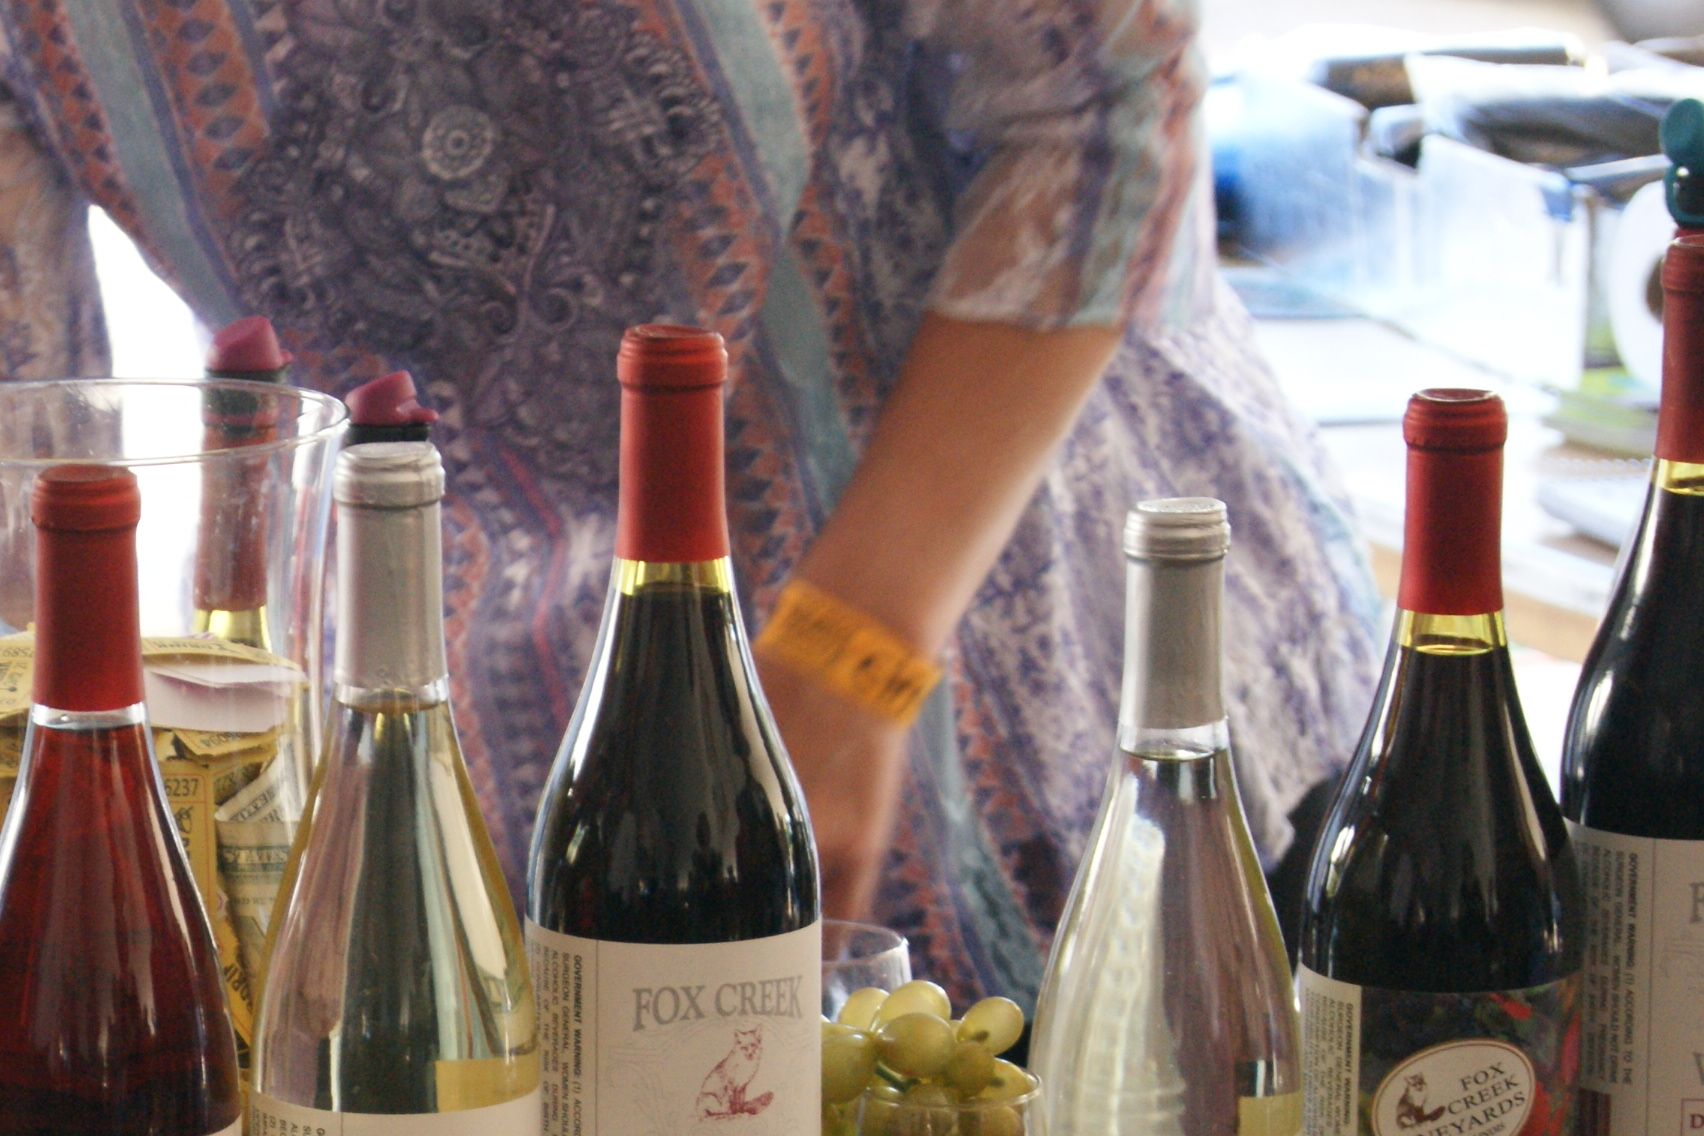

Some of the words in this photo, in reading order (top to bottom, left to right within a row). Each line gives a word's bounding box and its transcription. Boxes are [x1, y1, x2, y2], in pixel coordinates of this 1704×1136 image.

[573, 955, 582, 1023] GOVERNMENT
[633, 985, 705, 1031] FOX
[714, 975, 803, 1019] CREEK
[1448, 1075, 1520, 1115] CREEK
[1461, 1061, 1506, 1091] FOX
